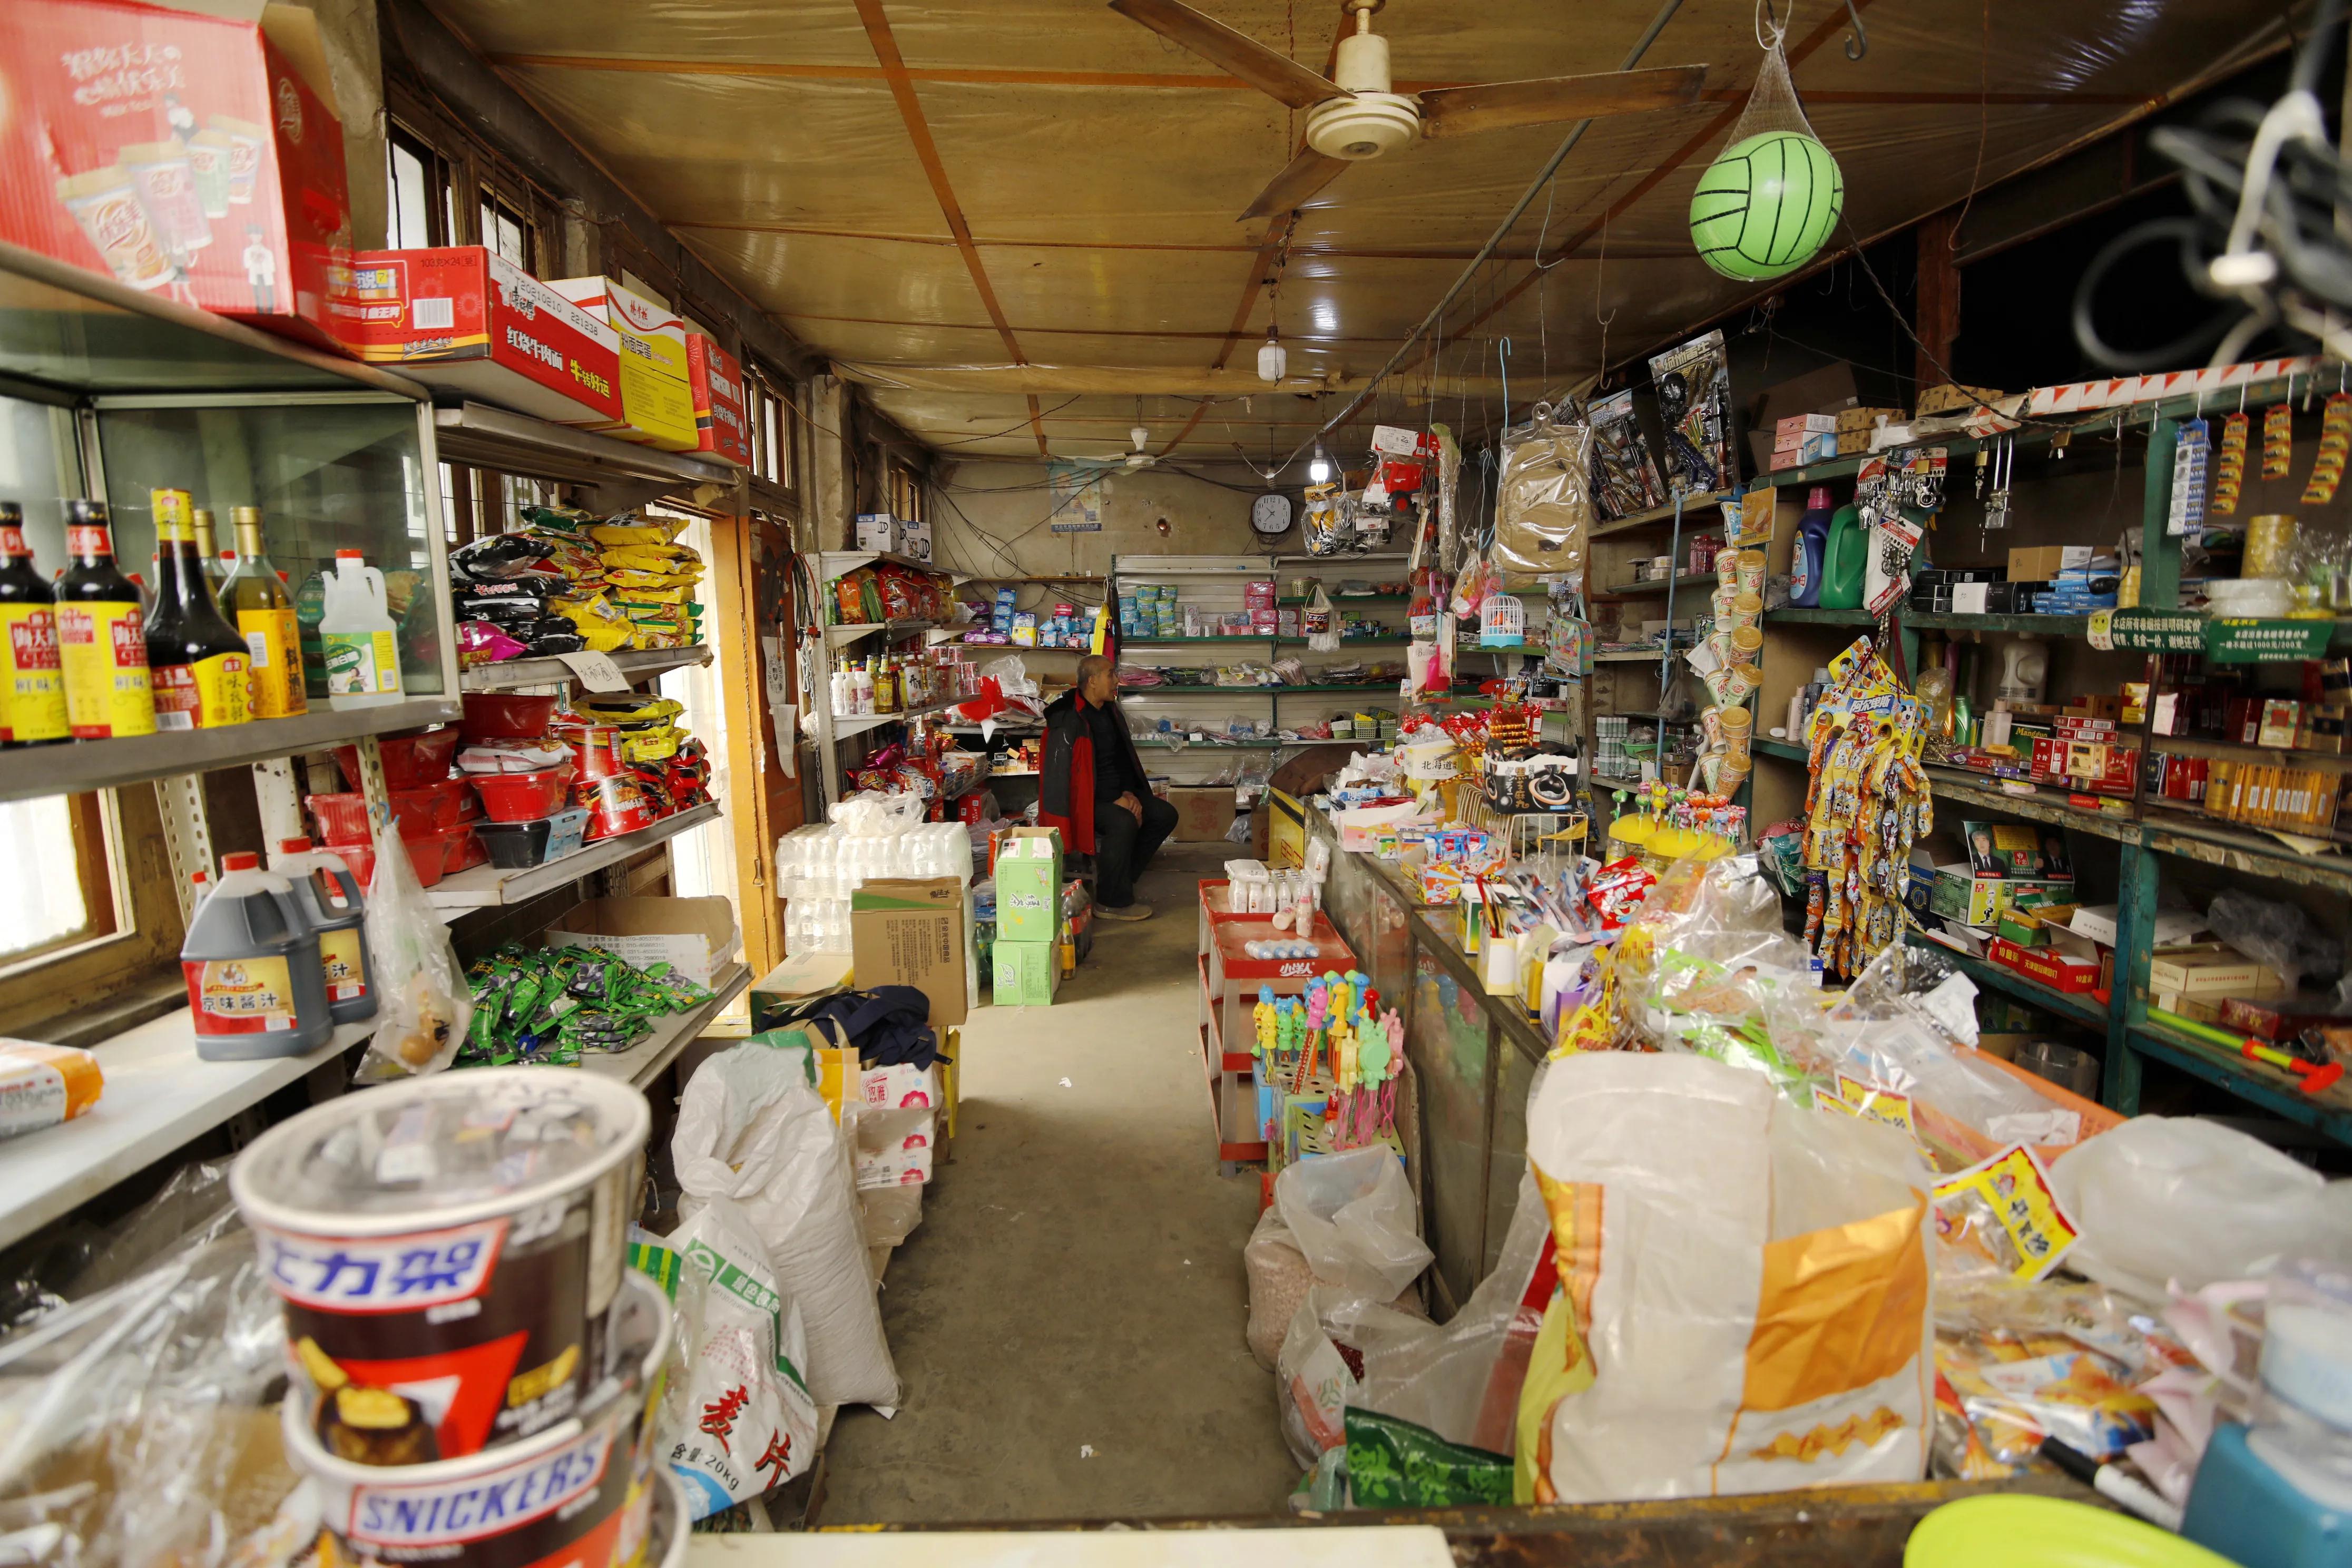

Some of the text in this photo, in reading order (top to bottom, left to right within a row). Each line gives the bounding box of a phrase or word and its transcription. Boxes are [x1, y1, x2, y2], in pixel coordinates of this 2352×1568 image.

[571, 311, 598, 336] 221238
[506, 325, 564, 371] 红烧牛肉面
[621, 331, 652, 360] 粉面菜蛋
[570, 358, 610, 398] 牛转好运
[474, 582, 518, 596] 불닭볶음면
[1848, 694, 1892, 717] 阿尔卑斯
[1422, 760, 1452, 770] 北海道
[1009, 893, 1041, 909] 绿茶
[1279, 962, 1313, 977] 小洋人
[202, 993, 277, 1011] 京味酱汁
[869, 1084, 885, 1103] 悠雅
[731, 1274, 781, 1314] 绿色食品
[361, 1434, 605, 1534] SNICKERS
